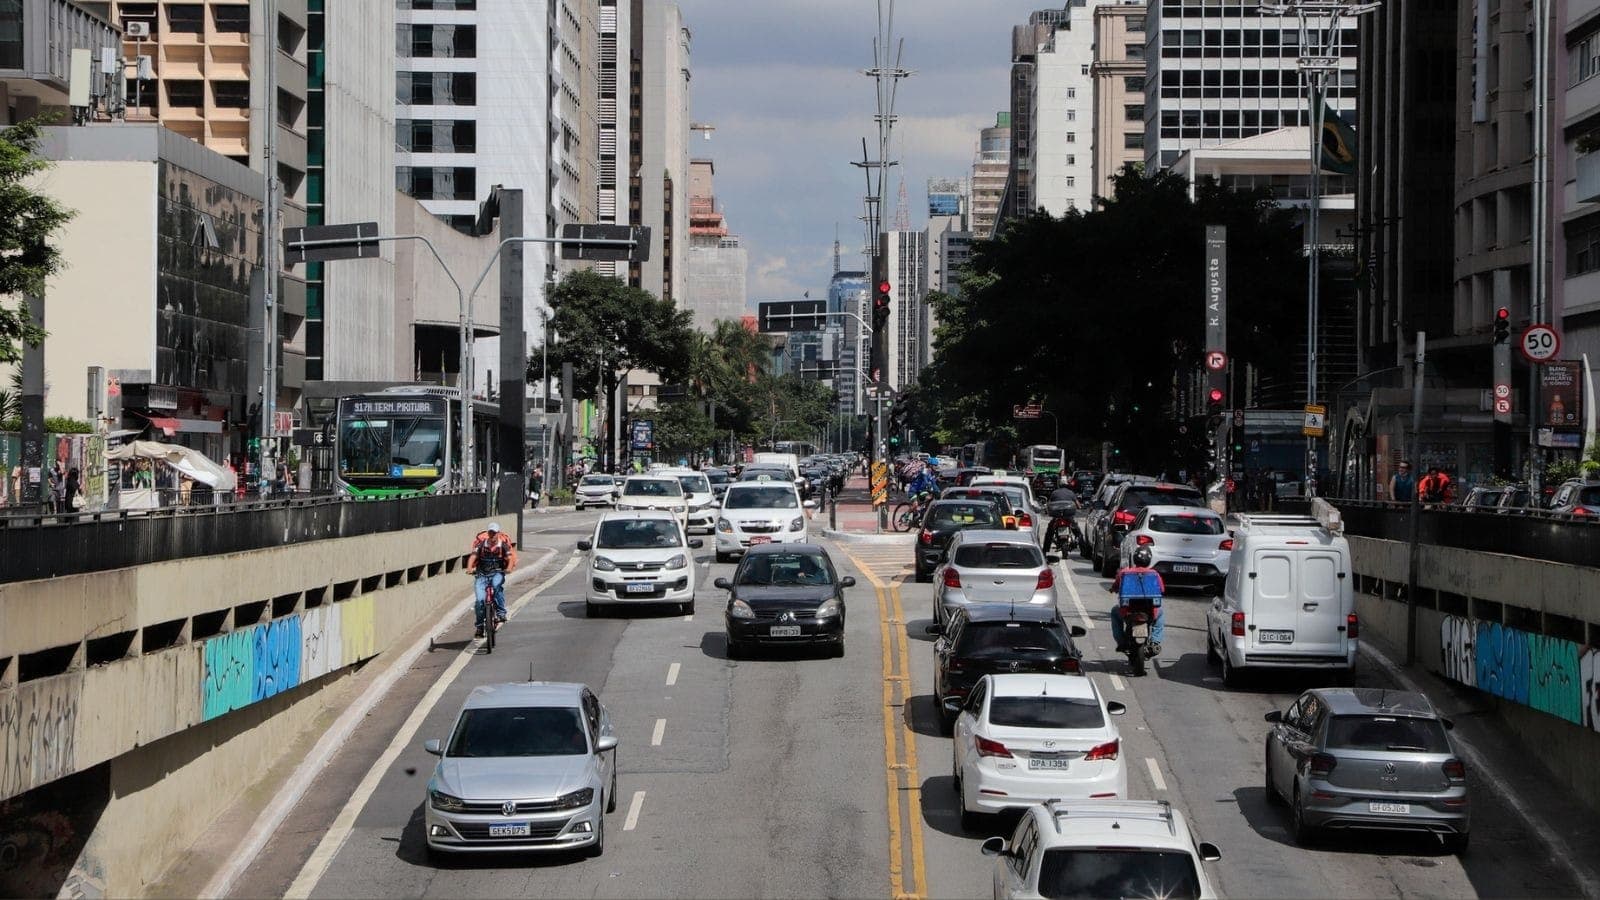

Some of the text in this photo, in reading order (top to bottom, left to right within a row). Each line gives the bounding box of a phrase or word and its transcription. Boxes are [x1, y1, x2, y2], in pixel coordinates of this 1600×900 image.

[1209, 258, 1222, 311] Augusta
[1528, 333, 1553, 350] 50
[396, 402, 430, 412] PIRITUBA
